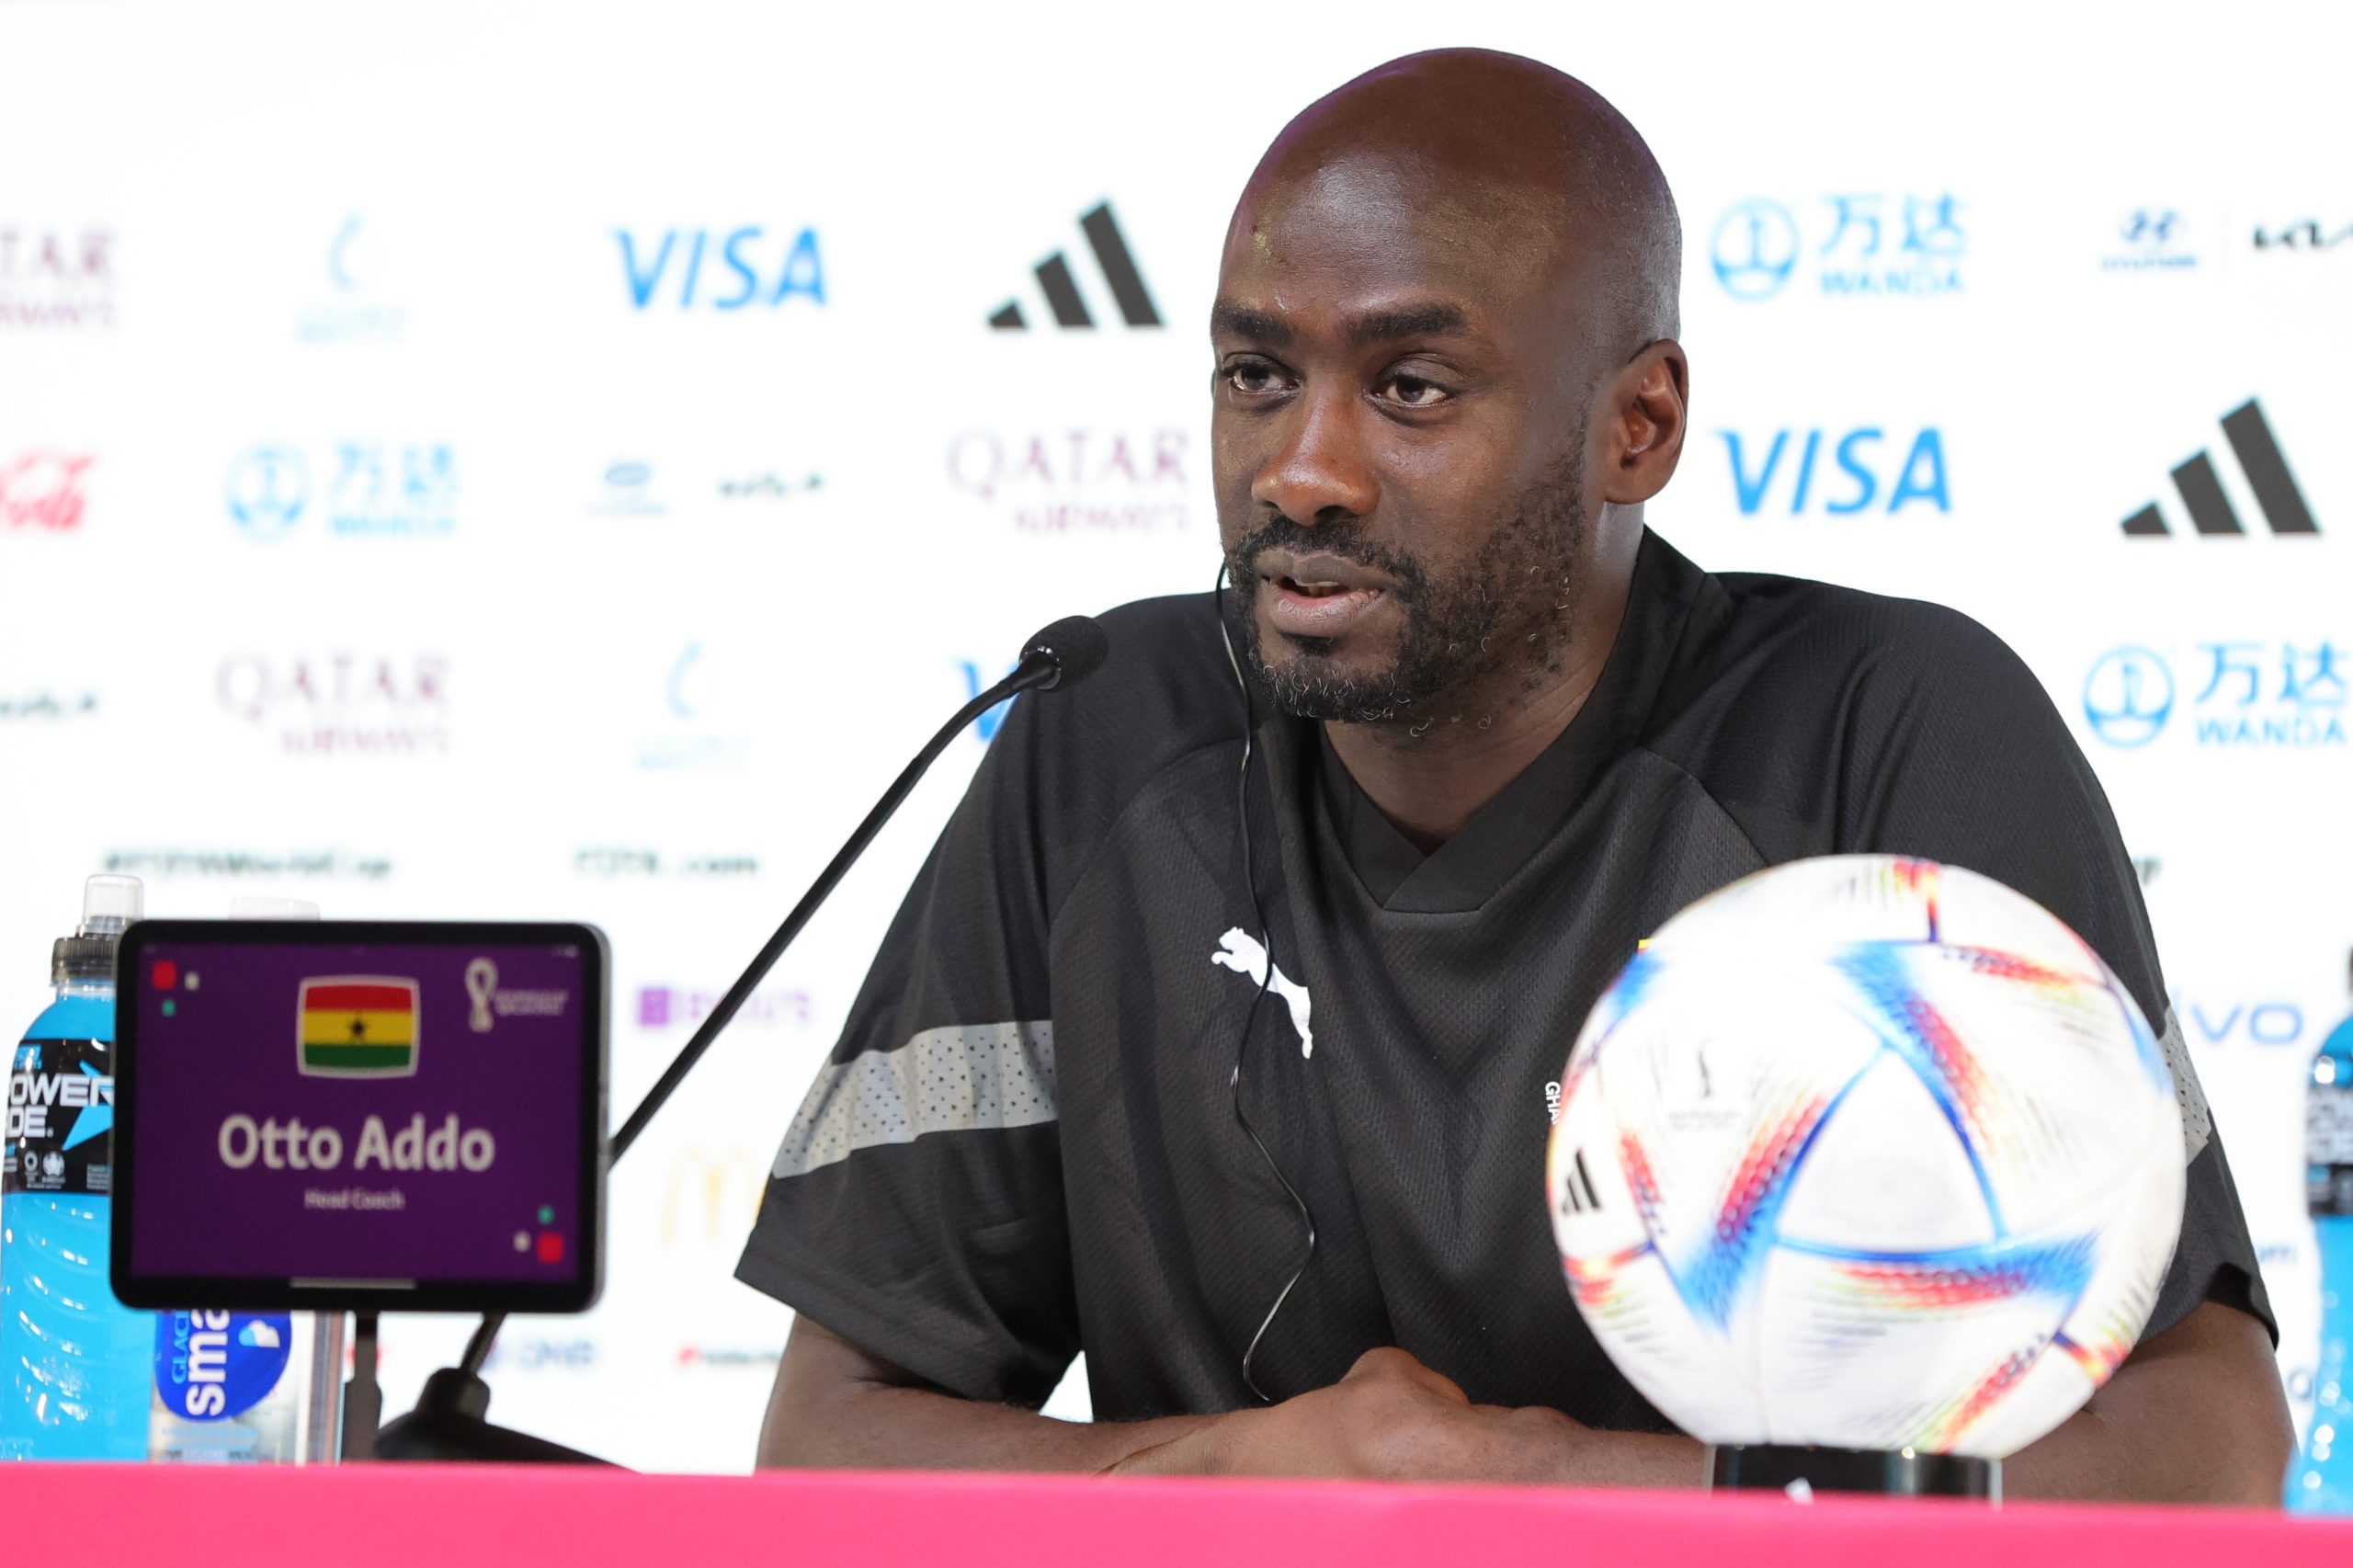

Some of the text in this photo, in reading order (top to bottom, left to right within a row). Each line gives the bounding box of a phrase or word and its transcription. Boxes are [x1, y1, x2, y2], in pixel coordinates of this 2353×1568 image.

[614, 226, 827, 311] VISA
[1820, 267, 1963, 295] WANDA
[948, 429, 1188, 501] QATAR
[1719, 427, 1951, 516] VISA
[2196, 641, 2347, 705] 万达
[2197, 717, 2347, 745] WANDA
[8, 1073, 114, 1107] OWER
[219, 1113, 495, 1172] Otto Addo
[304, 1188, 405, 1210] Head Coach
